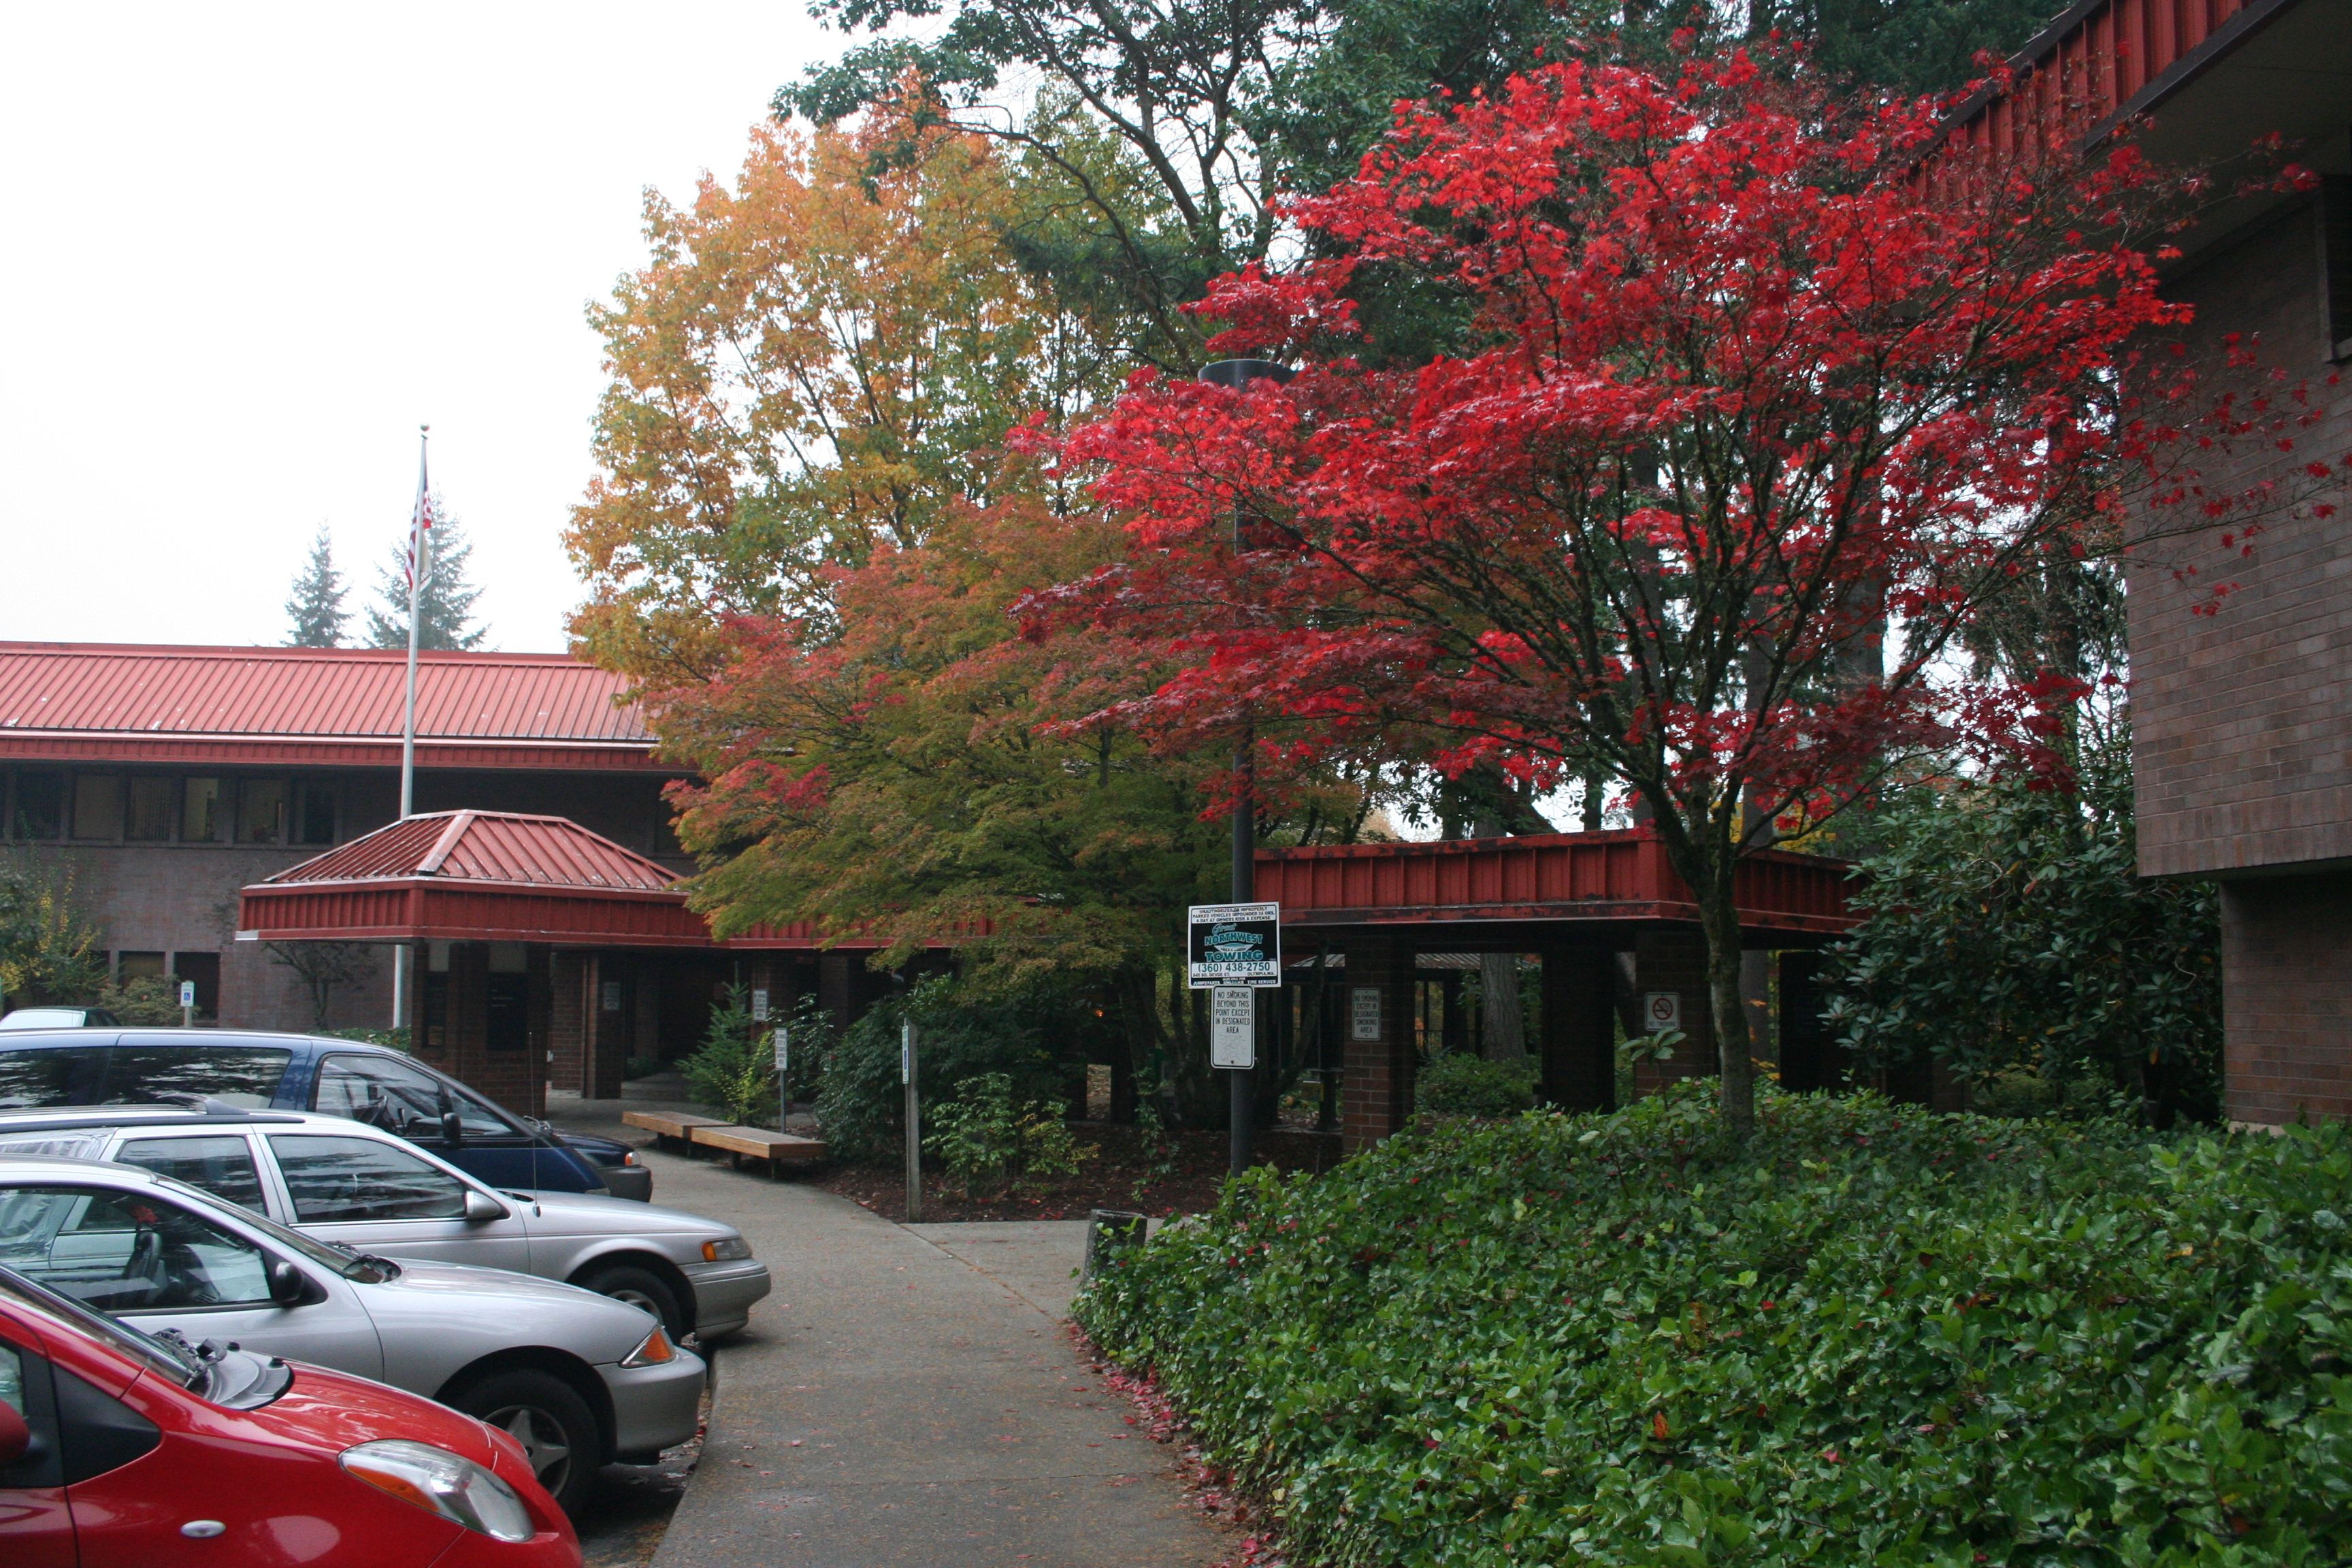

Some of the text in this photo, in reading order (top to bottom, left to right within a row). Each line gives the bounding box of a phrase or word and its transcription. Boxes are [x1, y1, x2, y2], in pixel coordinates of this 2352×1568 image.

[1204, 931, 1263, 946] NORTHWEST
[1205, 949, 1264, 962] TOWING
[1198, 962, 1270, 973] (360) 438-2750
